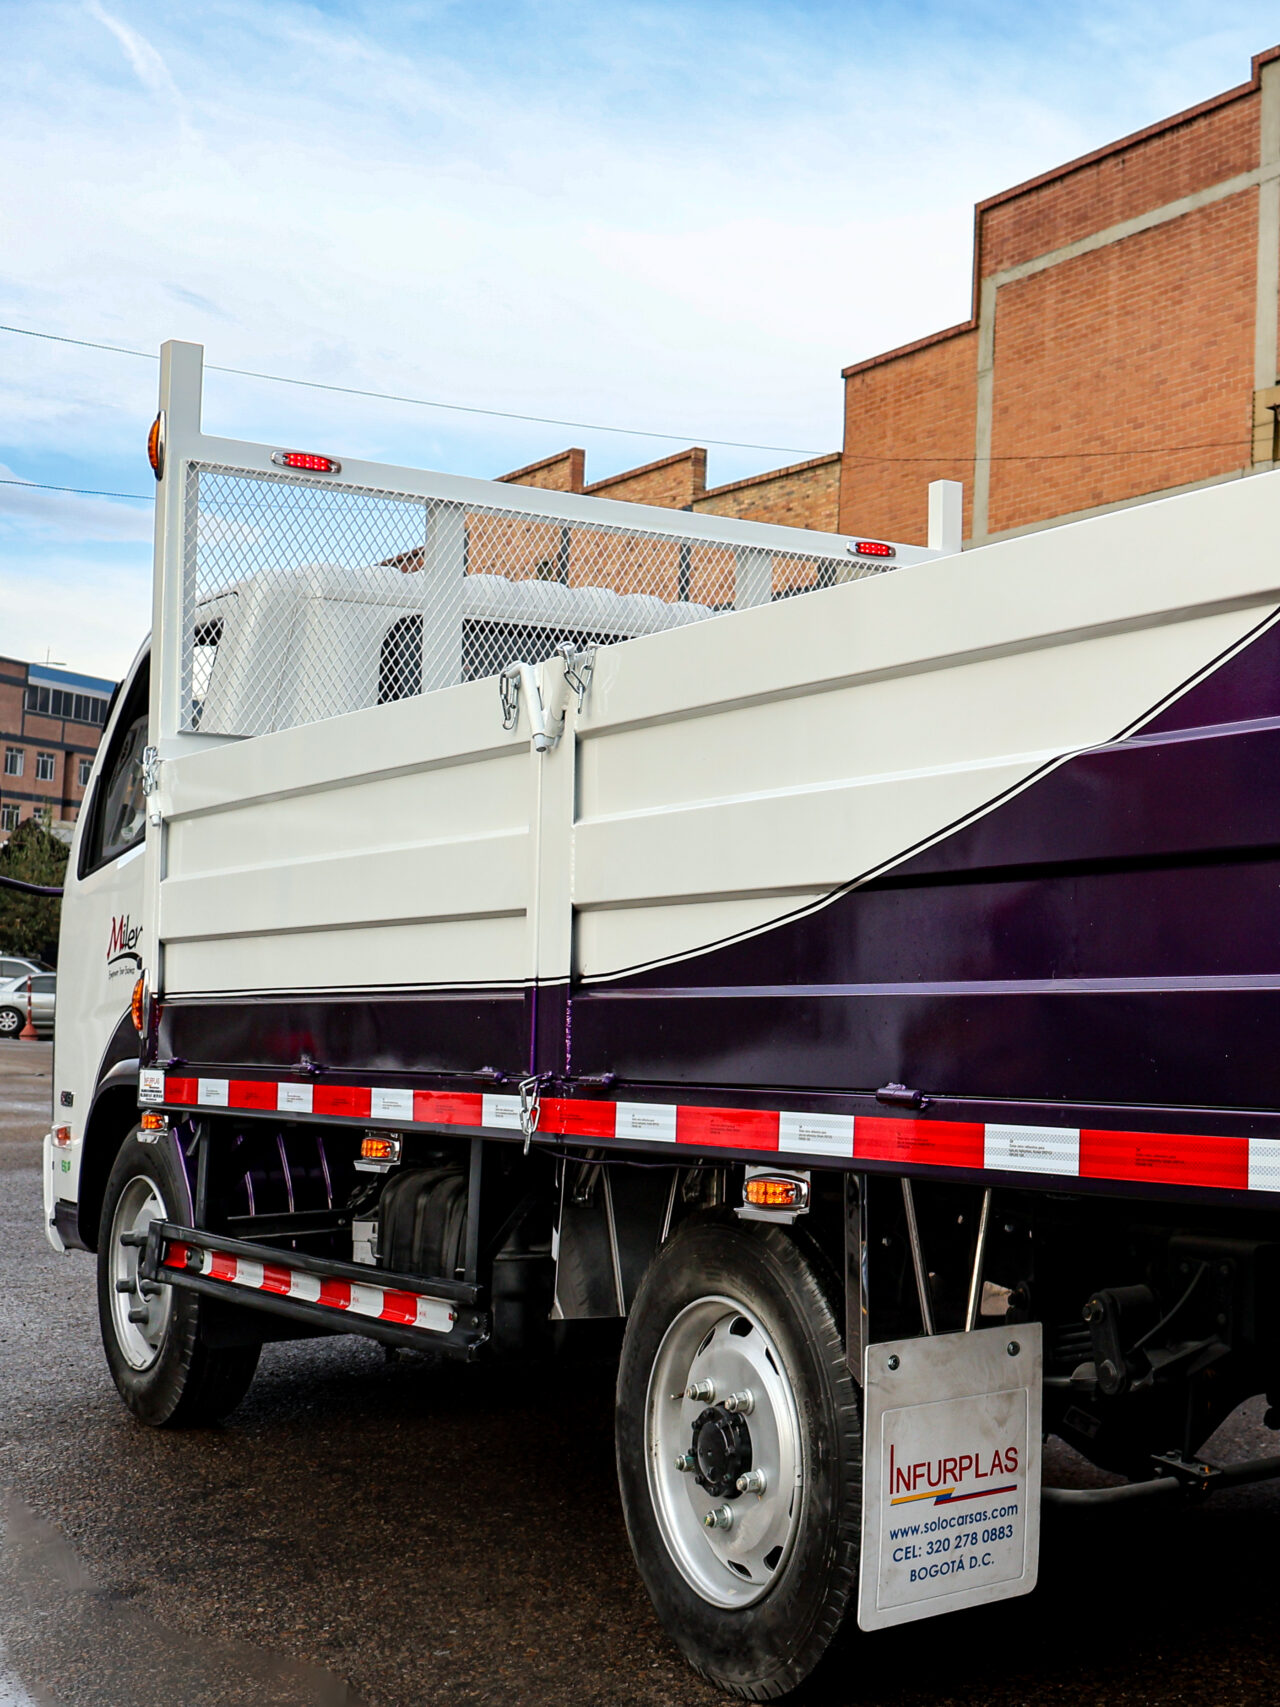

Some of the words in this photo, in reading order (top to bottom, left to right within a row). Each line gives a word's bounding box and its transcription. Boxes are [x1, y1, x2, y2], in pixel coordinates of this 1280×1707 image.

[107, 914, 143, 960] Miler
[889, 1444, 1018, 1495] INFURPLAS
[889, 1504, 1018, 1541] www.solocarsas.com
[892, 1544, 922, 1562] CEL:
[926, 1537, 950, 1555] 320
[954, 1531, 978, 1550] 278
[981, 1524, 1013, 1543] 0883
[910, 1554, 965, 1582] BOGOTÁ
[969, 1552, 995, 1569] D.C.
